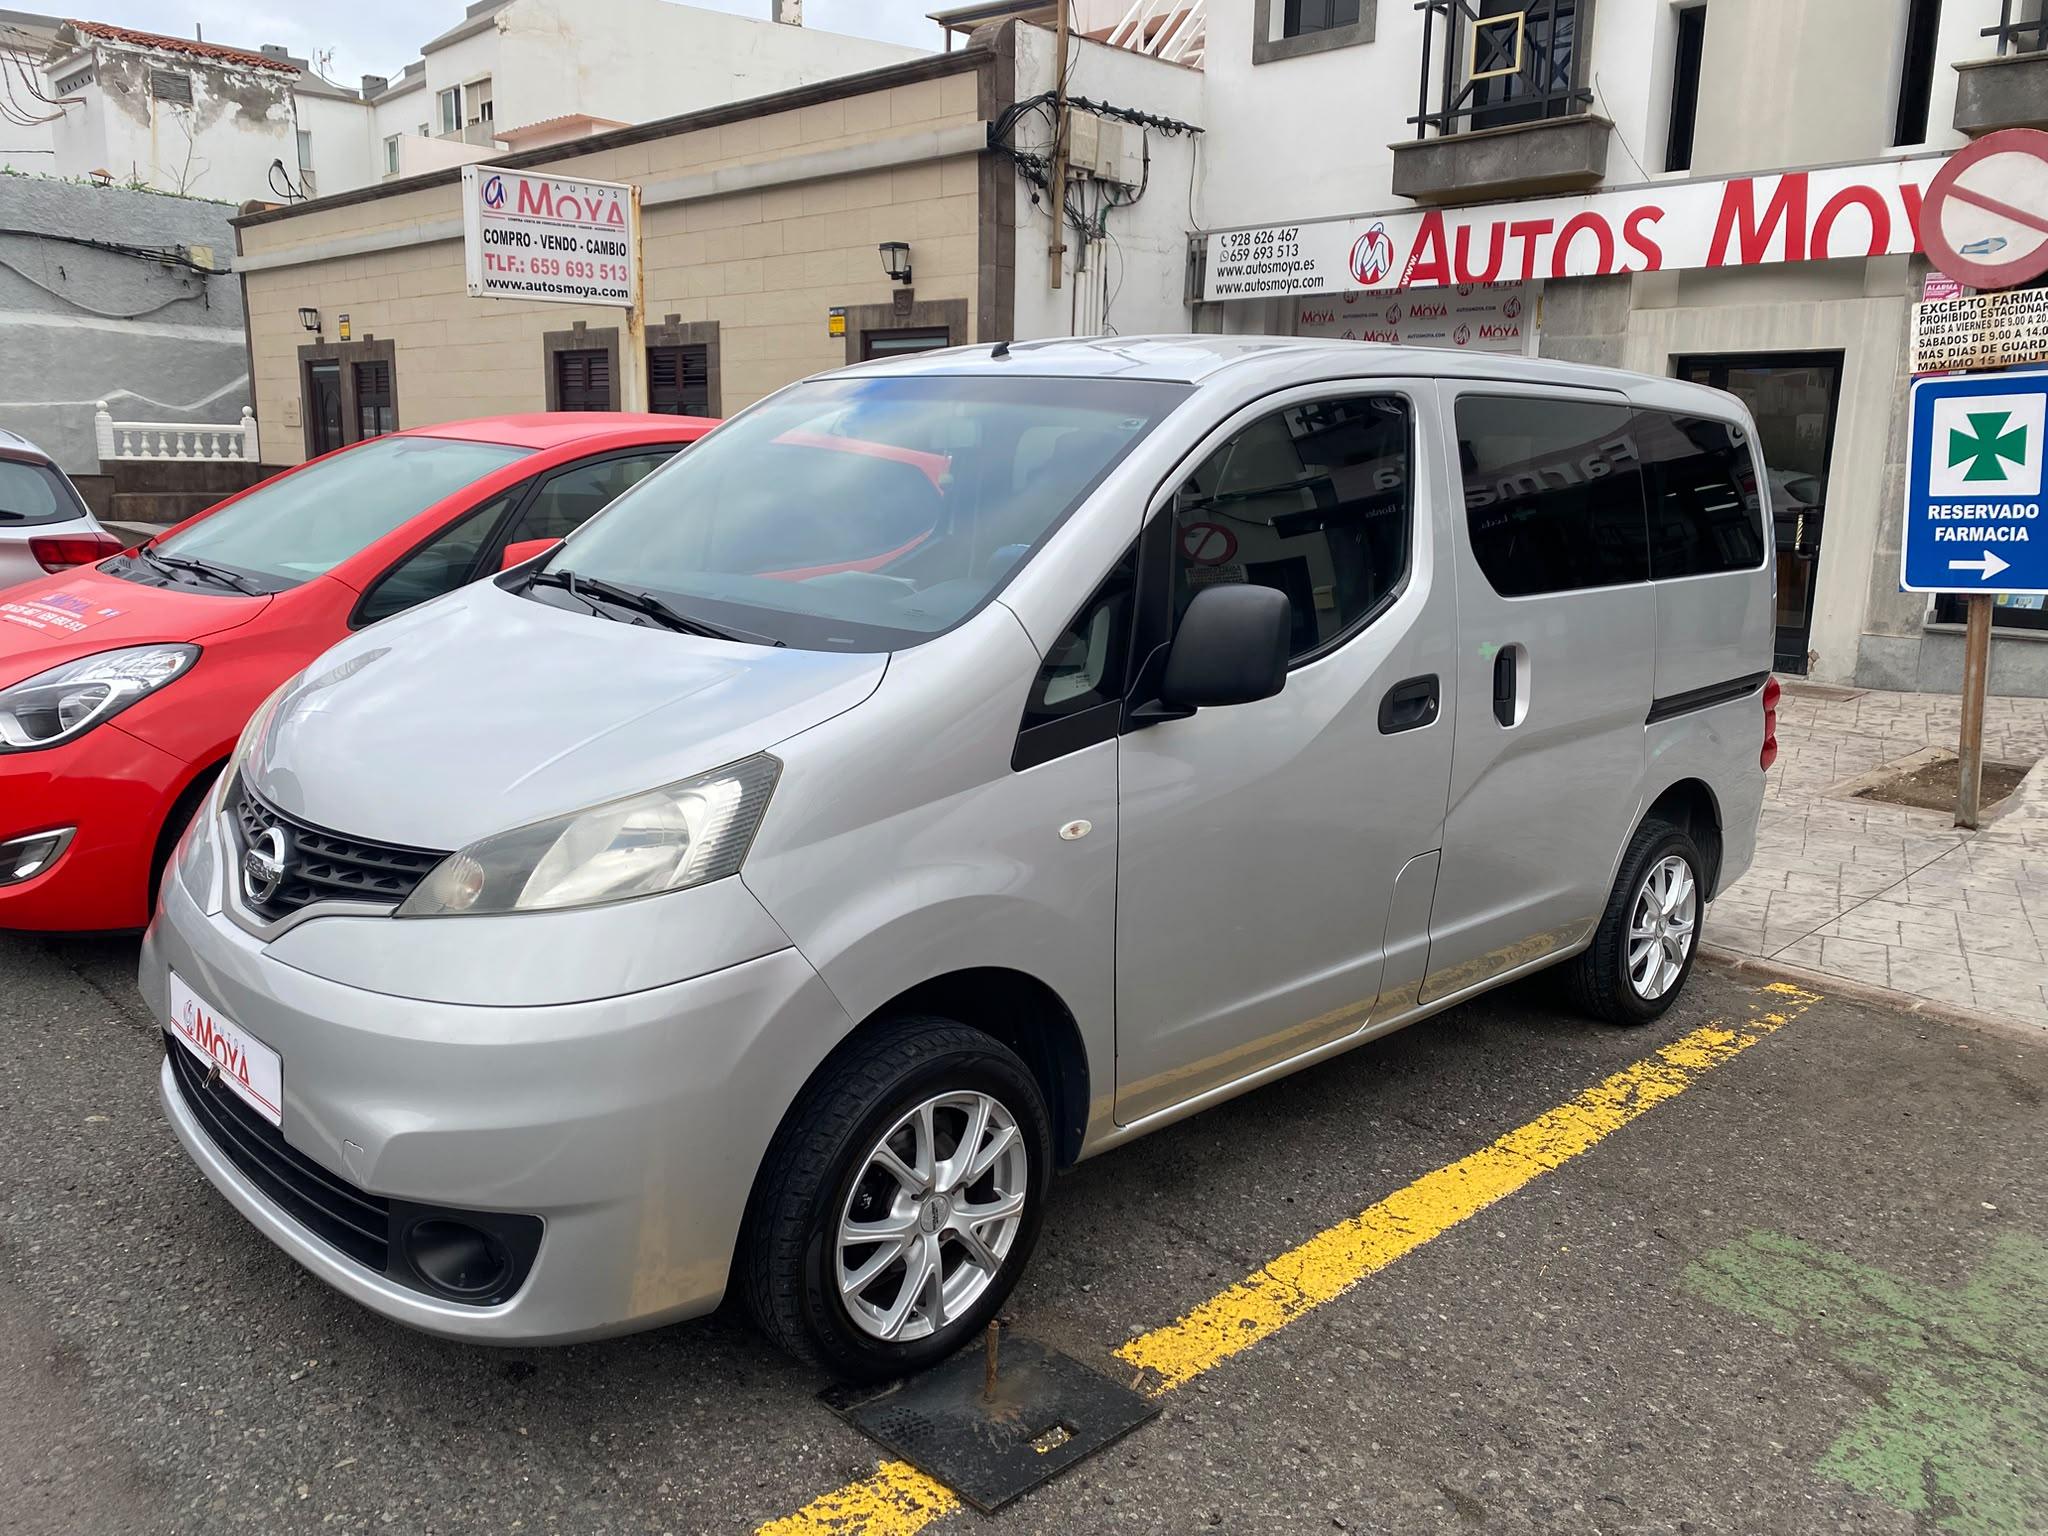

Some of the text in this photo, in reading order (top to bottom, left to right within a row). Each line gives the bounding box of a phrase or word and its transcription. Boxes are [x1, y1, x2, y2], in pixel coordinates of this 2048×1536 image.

[554, 183, 619, 199] AUTOS
[517, 179, 625, 225] MOYA
[1230, 228, 1299, 247] 928 626 467
[1399, 171, 1924, 288] AUTOS MOY
[483, 228, 531, 247] COMPRO
[540, 234, 577, 252] VENDO
[586, 239, 627, 257] CAMBIO
[1229, 243, 1299, 262] 659 693 513
[484, 252, 628, 282] TLF.: 659 693 513
[1216, 259, 1315, 277] www.autosmoya.es
[486, 278, 629, 298] www.autosmoya.com
[1215, 276, 1324, 294] www.autosmoya.com
[1409, 303, 1448, 317] MOYA
[1919, 302, 2048, 325] PROHIBIDO ESTACIONAR
[1920, 297, 1987, 315] EXCEPTO
[1301, 311, 1335, 324] MOYA
[1919, 324, 1945, 336] LUNES
[1948, 323, 1953, 332] A
[1956, 320, 1992, 332] VIERNES
[1994, 318, 2005, 328] DE
[2008, 316, 2025, 327] 9.00
[2027, 315, 2034, 324] A
[1478, 324, 1520, 337] MOYA
[1972, 333, 1986, 343] DE
[1989, 330, 2011, 341] 9.00
[2015, 329, 2022, 338] A
[1981, 344, 1997, 354] DE
[2002, 339, 2047, 352] GUARD
[1979, 355, 1995, 365] 15
[2000, 351, 2048, 364] MINUT
[1928, 503, 2040, 520] RESERVADO
[1934, 526, 2030, 542] FARMACIA
[196, 1007, 250, 1086] MOYA
